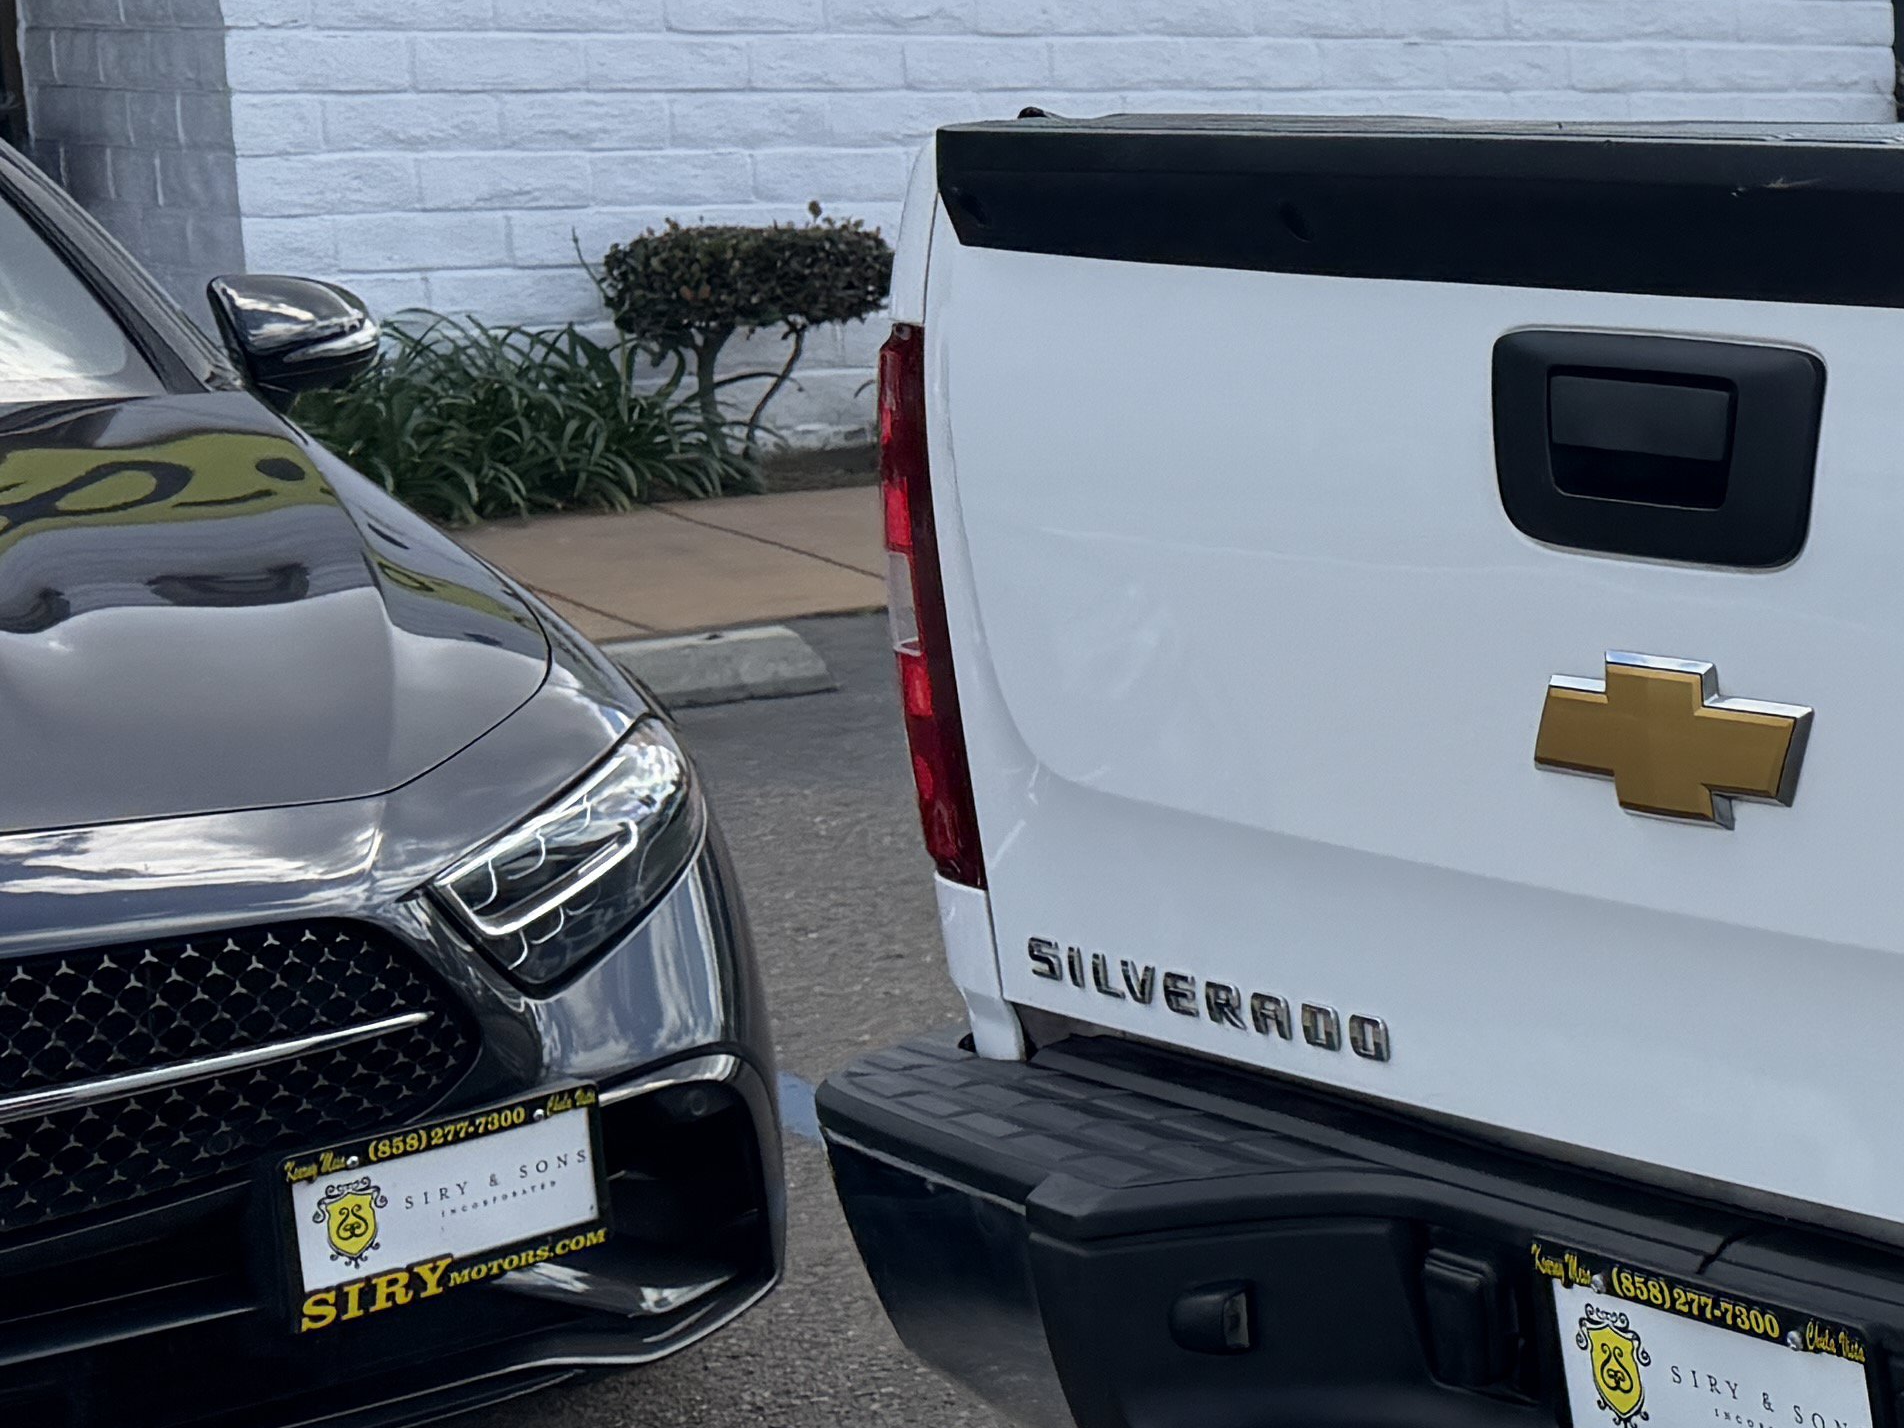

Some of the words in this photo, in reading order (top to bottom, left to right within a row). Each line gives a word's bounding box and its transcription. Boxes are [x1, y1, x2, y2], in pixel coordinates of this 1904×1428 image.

[1027, 935, 1391, 1063] SILVERADO
[369, 1129, 427, 1162] (858)
[431, 1106, 526, 1146] 277-7300
[404, 1182, 468, 1210] SIRY
[488, 1172, 500, 1188] &
[518, 1149, 587, 1179] SONS
[301, 1257, 453, 1333] SIRY
[448, 1227, 607, 1288] MOTORS.COM
[1611, 1267, 1671, 1310] (858)
[1674, 1288, 1780, 1340] 277-7300
[1671, 1365, 1739, 1401] SIRY
[1762, 1392, 1774, 1413] &
